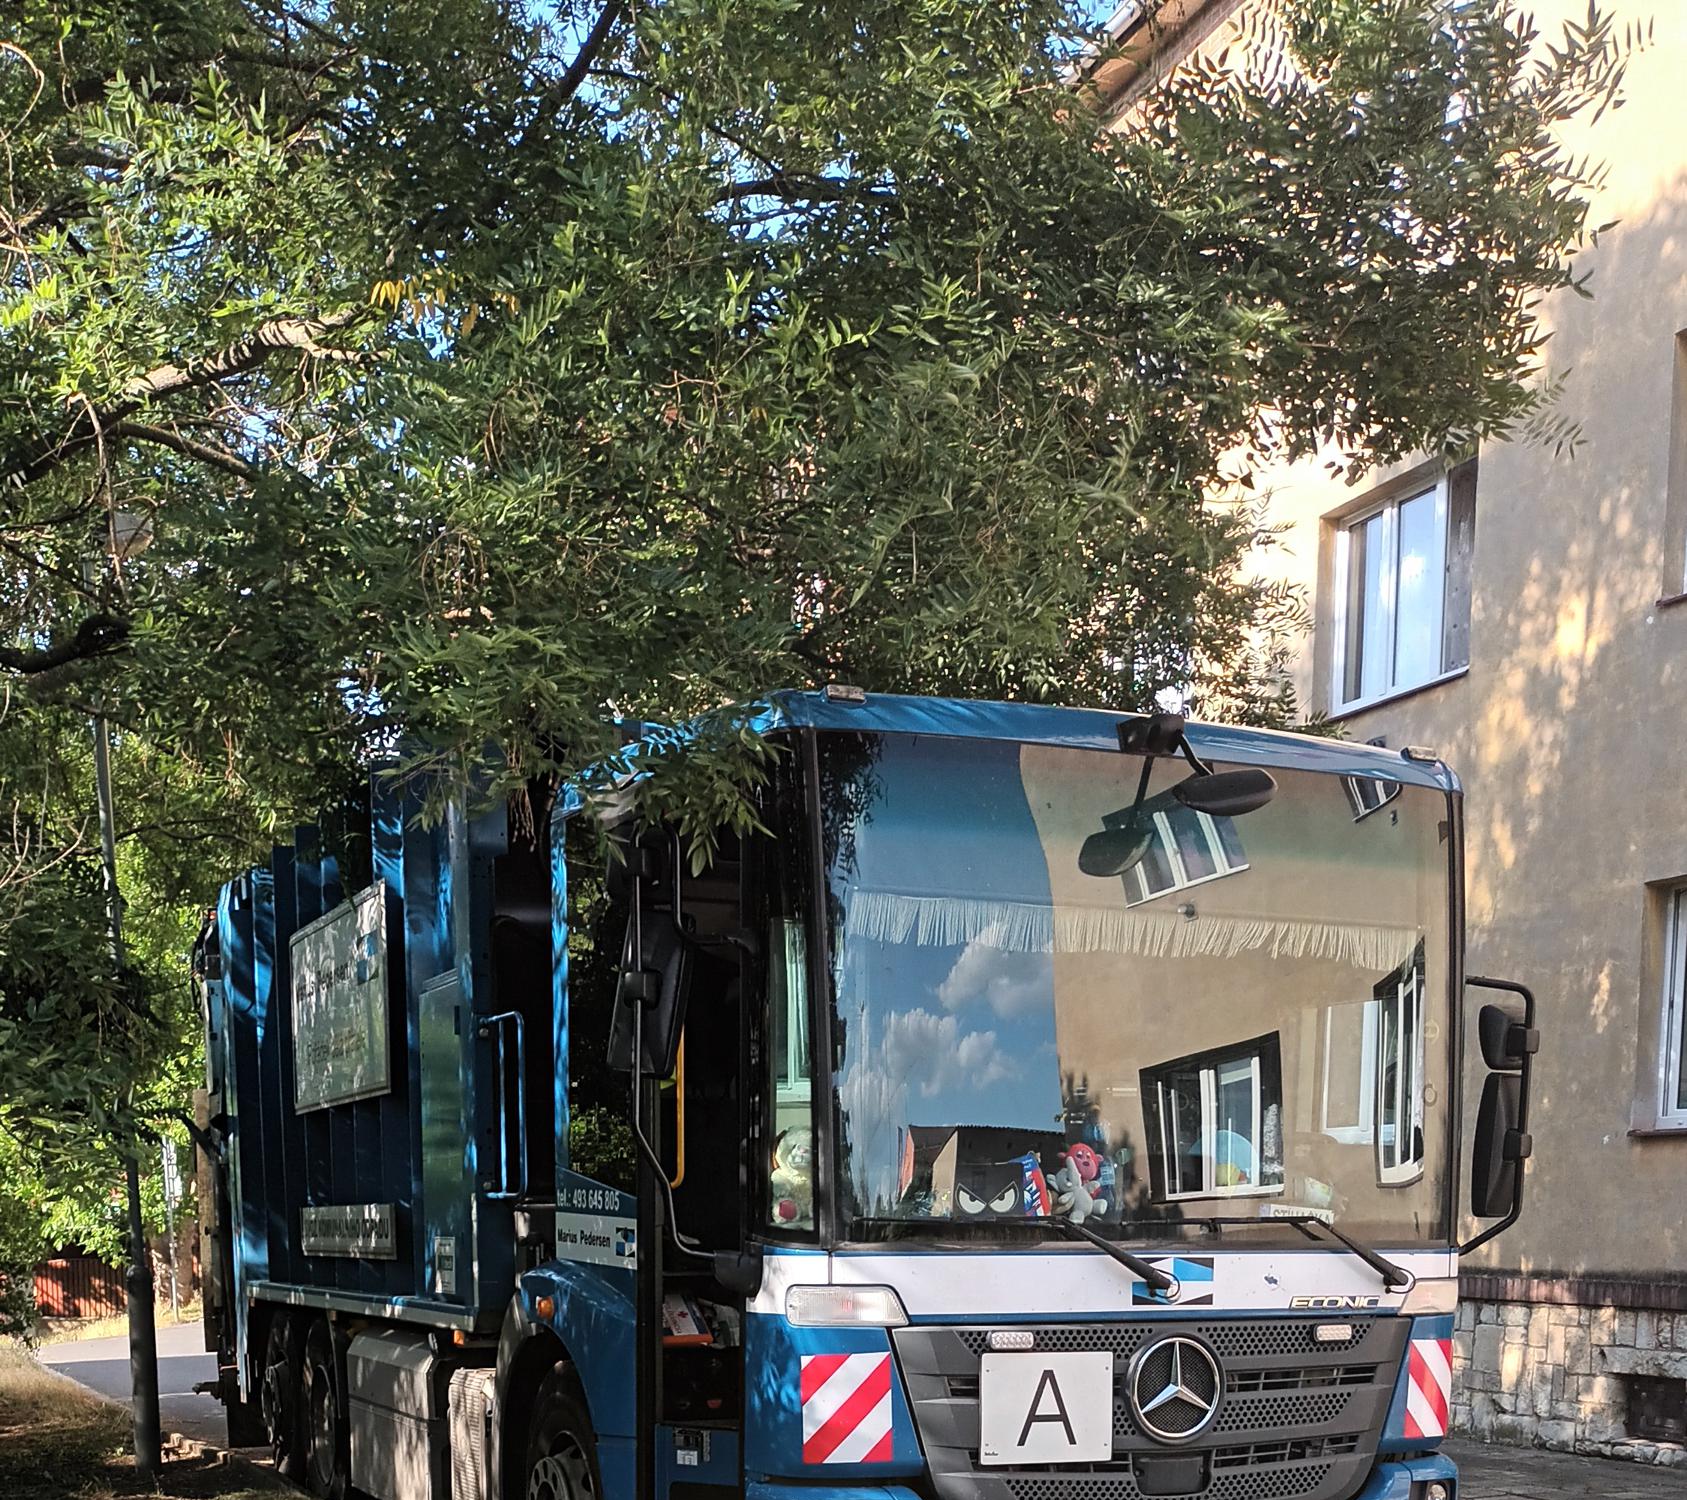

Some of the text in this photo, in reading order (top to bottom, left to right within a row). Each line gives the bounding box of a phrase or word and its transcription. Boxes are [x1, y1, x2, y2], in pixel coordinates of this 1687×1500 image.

[573, 1188, 587, 1208] 493
[588, 1189, 603, 1210] 645
[604, 1190, 620, 1212] 805
[558, 1228, 610, 1248] Marius Pedersen
[1289, 1295, 1380, 1309] ECONIC
[1016, 1369, 1078, 1447] A
